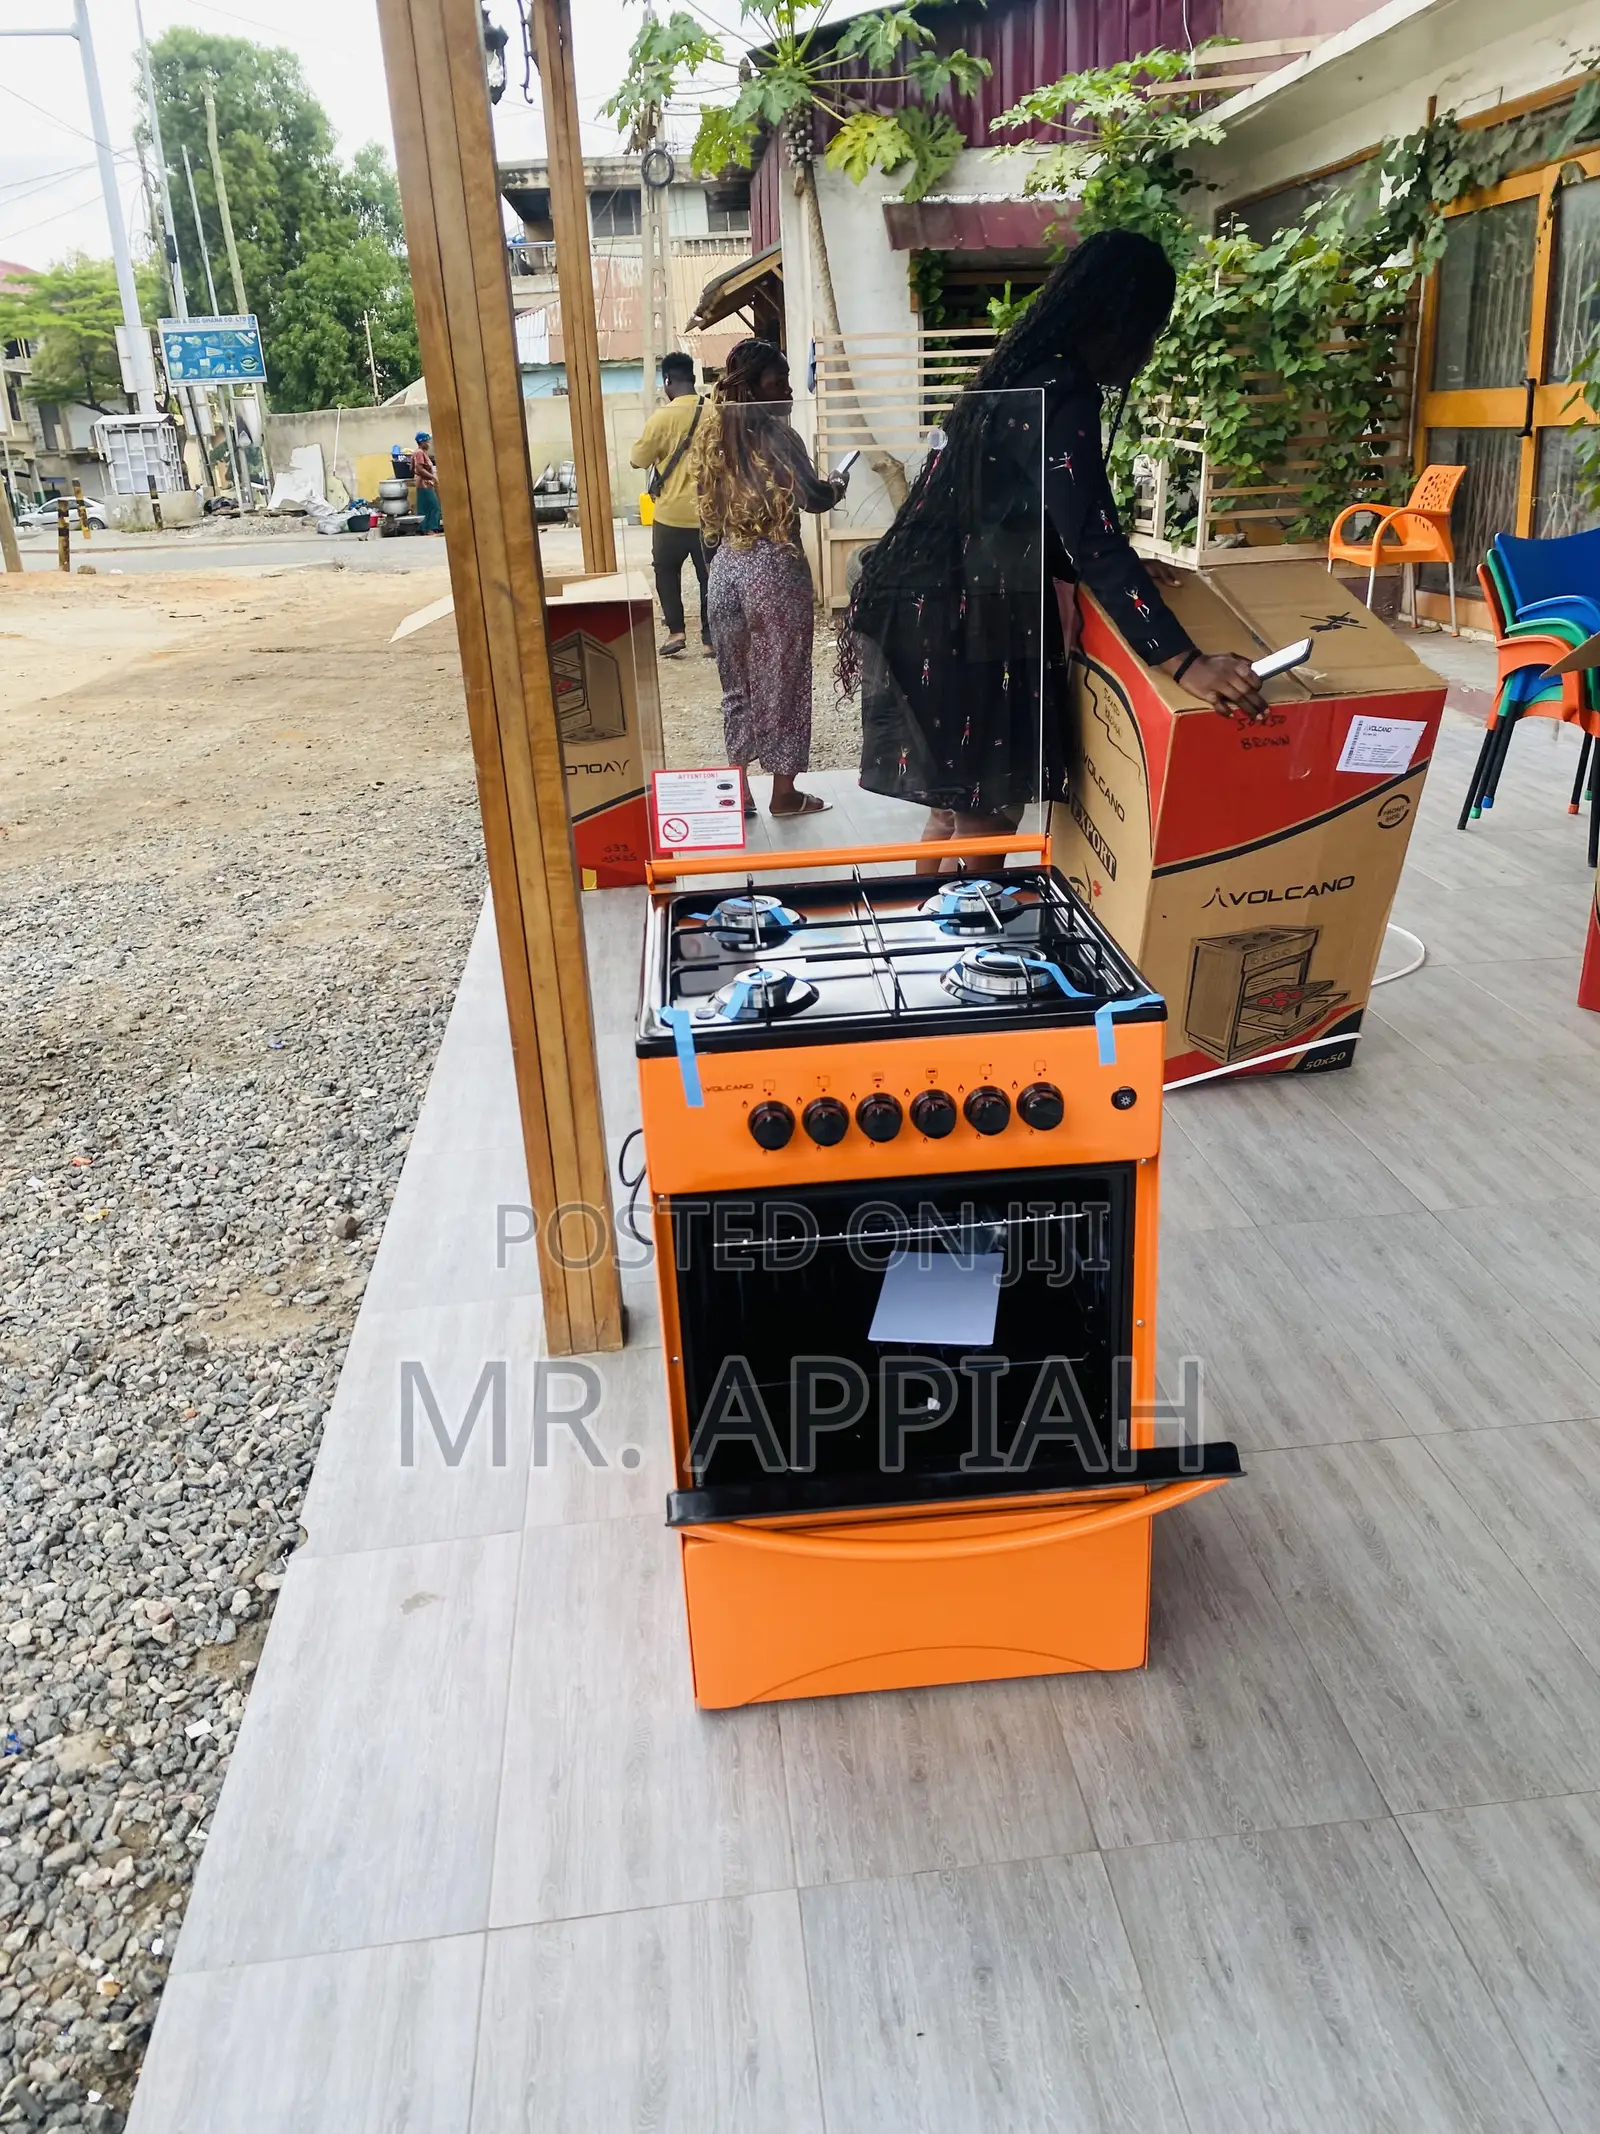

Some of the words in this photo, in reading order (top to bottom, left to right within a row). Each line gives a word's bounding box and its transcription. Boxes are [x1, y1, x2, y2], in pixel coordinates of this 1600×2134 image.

[565, 763, 615, 776] VOLC
[677, 772, 718, 780] ATTENTION!
[1080, 747, 1125, 823] VOLCANO
[1229, 876, 1355, 906] VOLCANO
[1304, 1052, 1346, 1070] 50x50
[706, 1083, 754, 1092] VOLCANO
